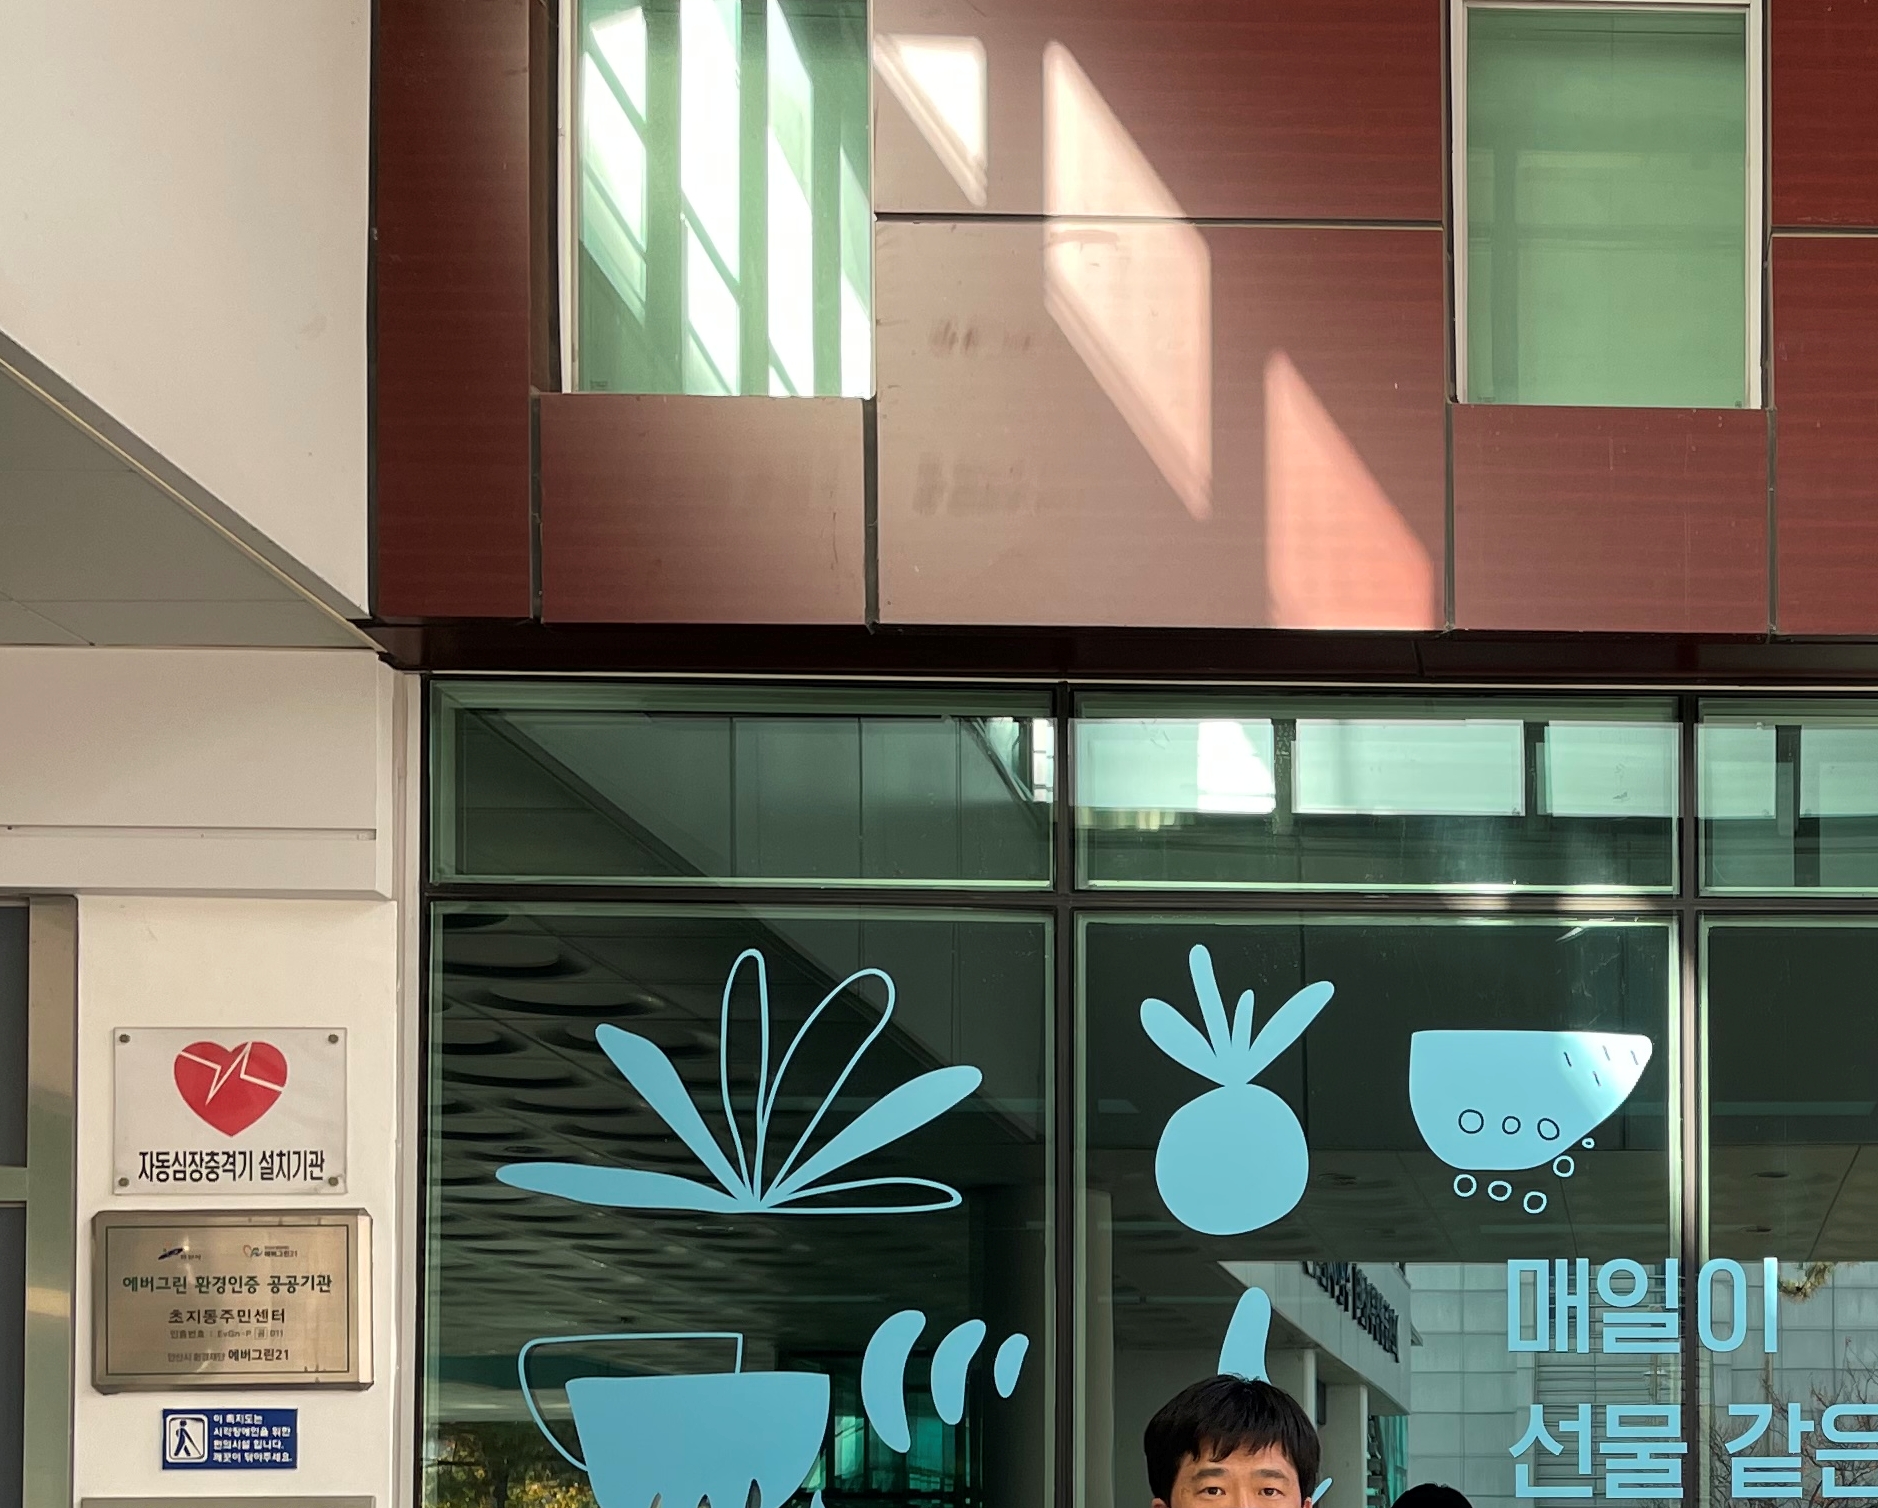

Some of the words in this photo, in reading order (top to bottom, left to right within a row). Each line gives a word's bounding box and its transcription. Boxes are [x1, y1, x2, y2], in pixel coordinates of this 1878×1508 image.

[138, 1150, 254, 1183] 자동심장충격기
[259, 1150, 325, 1182] 설치기관
[123, 1275, 188, 1294] 에버그린
[195, 1275, 260, 1294] 환경인증
[267, 1274, 332, 1293] 공공기관
[168, 1308, 286, 1324] 초지동주민센터
[1507, 1256, 1778, 1354] 매일이
[228, 1348, 289, 1361] 에버그린21
[1508, 1403, 1687, 1499] 선물
